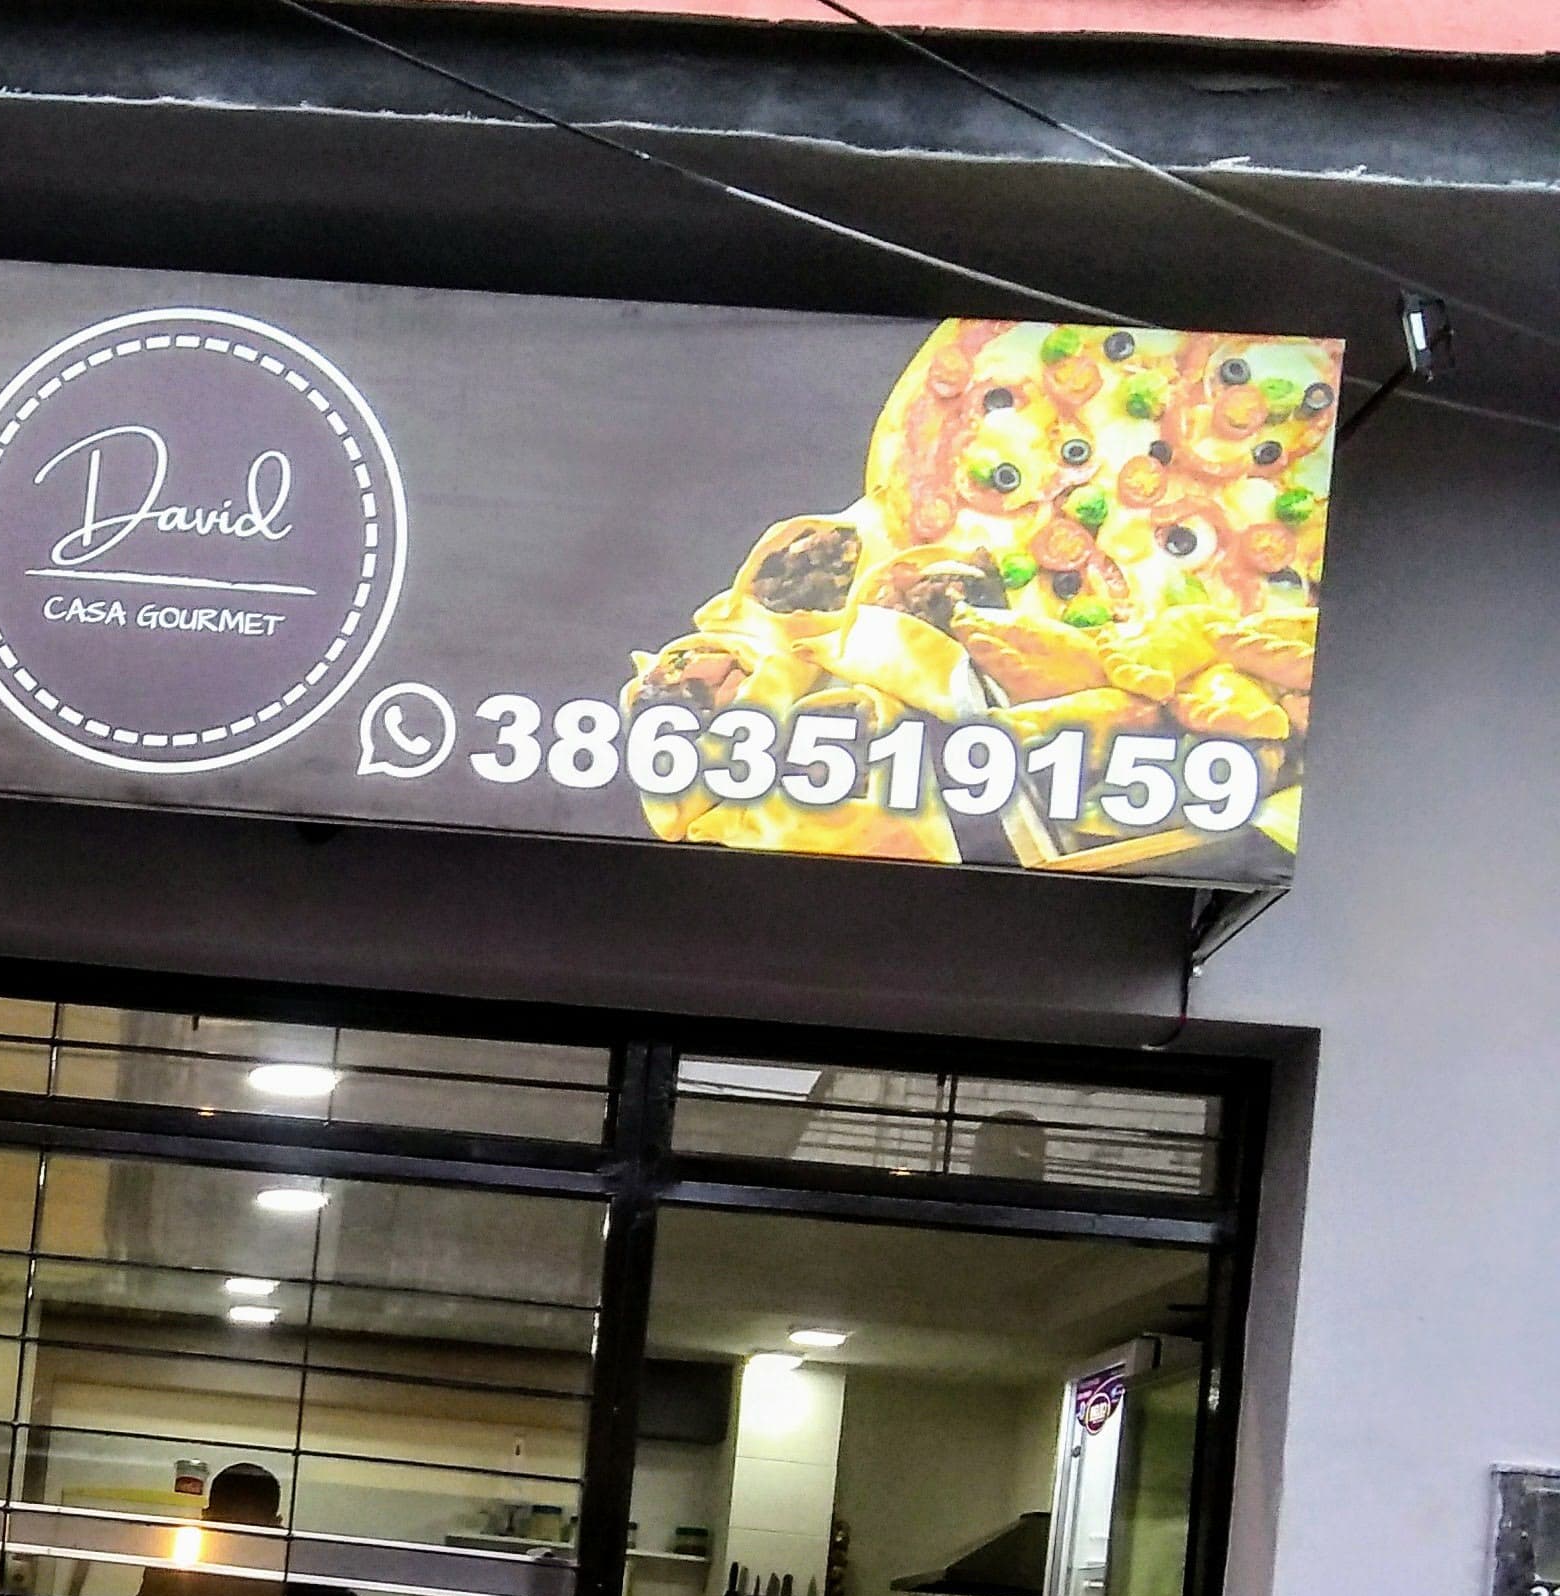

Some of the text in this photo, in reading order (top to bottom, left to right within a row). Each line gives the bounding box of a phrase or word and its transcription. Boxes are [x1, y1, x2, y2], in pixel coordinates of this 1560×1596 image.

[34, 425, 293, 566] David
[43, 595, 286, 637] CASA GOURMET
[469, 694, 1260, 832] 3863519159
